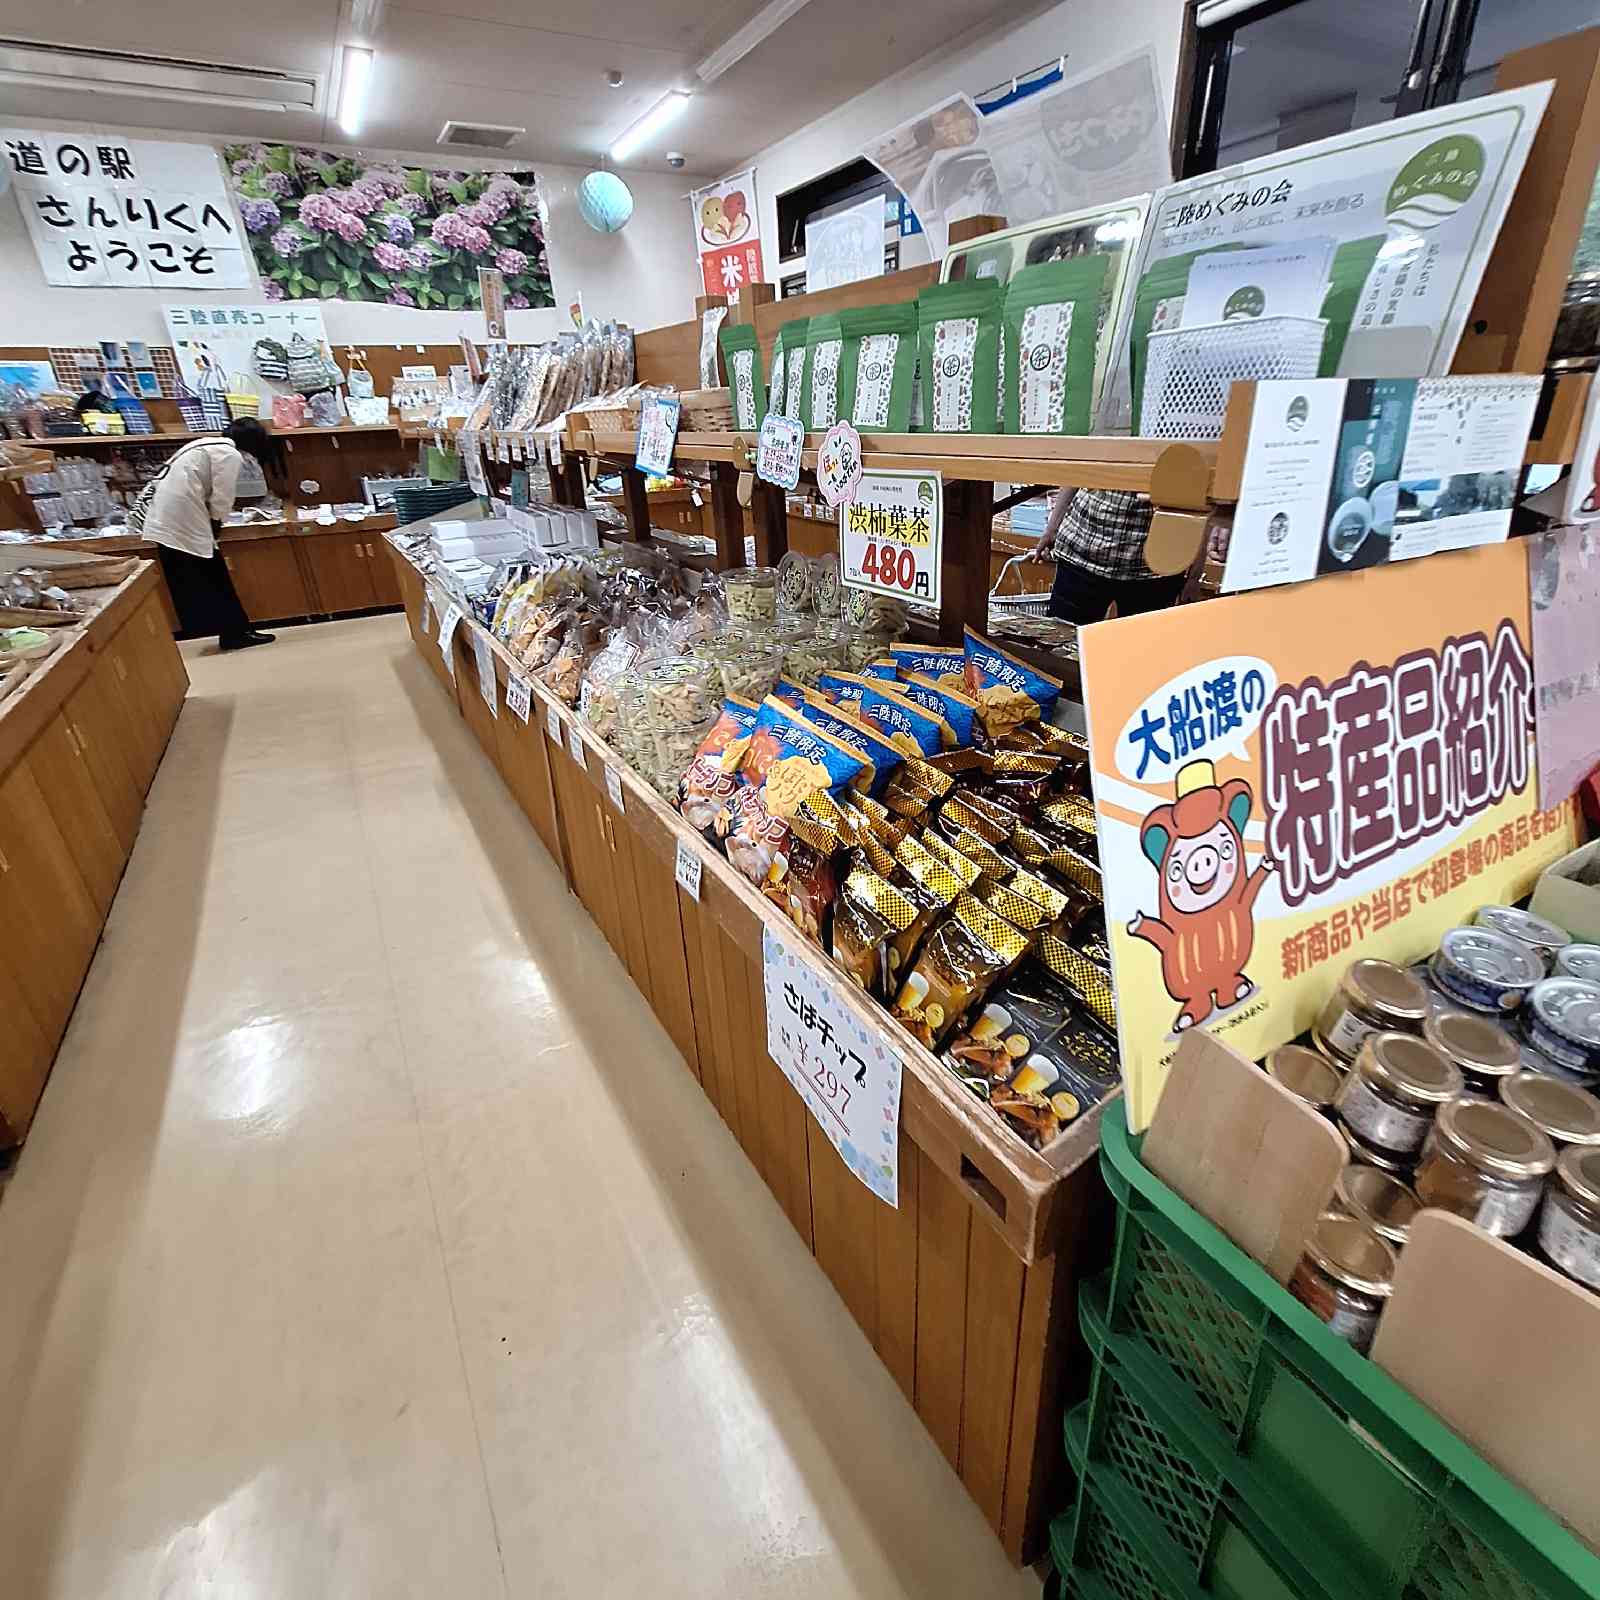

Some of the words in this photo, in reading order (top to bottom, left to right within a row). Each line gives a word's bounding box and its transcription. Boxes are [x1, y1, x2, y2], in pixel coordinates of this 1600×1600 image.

[5, 140, 136, 180] 道の駅
[37, 195, 233, 234] さんりくへ
[1161, 178, 1293, 230] 三陸めぐみの会
[66, 240, 215, 274] ようこそ
[849, 501, 930, 543] 渋柿葉茶
[862, 543, 929, 597] 480円
[912, 656, 965, 674] 三陸限定
[971, 652, 1026, 692] 三陸限定
[815, 718, 868, 750] 三陸限定
[868, 704, 912, 737] 三陸限定
[1128, 669, 1265, 780] 大船渡の
[769, 724, 827, 766] 三陸限定
[1263, 622, 1532, 902] 特産品紹介
[783, 981, 866, 1089] さばチップ
